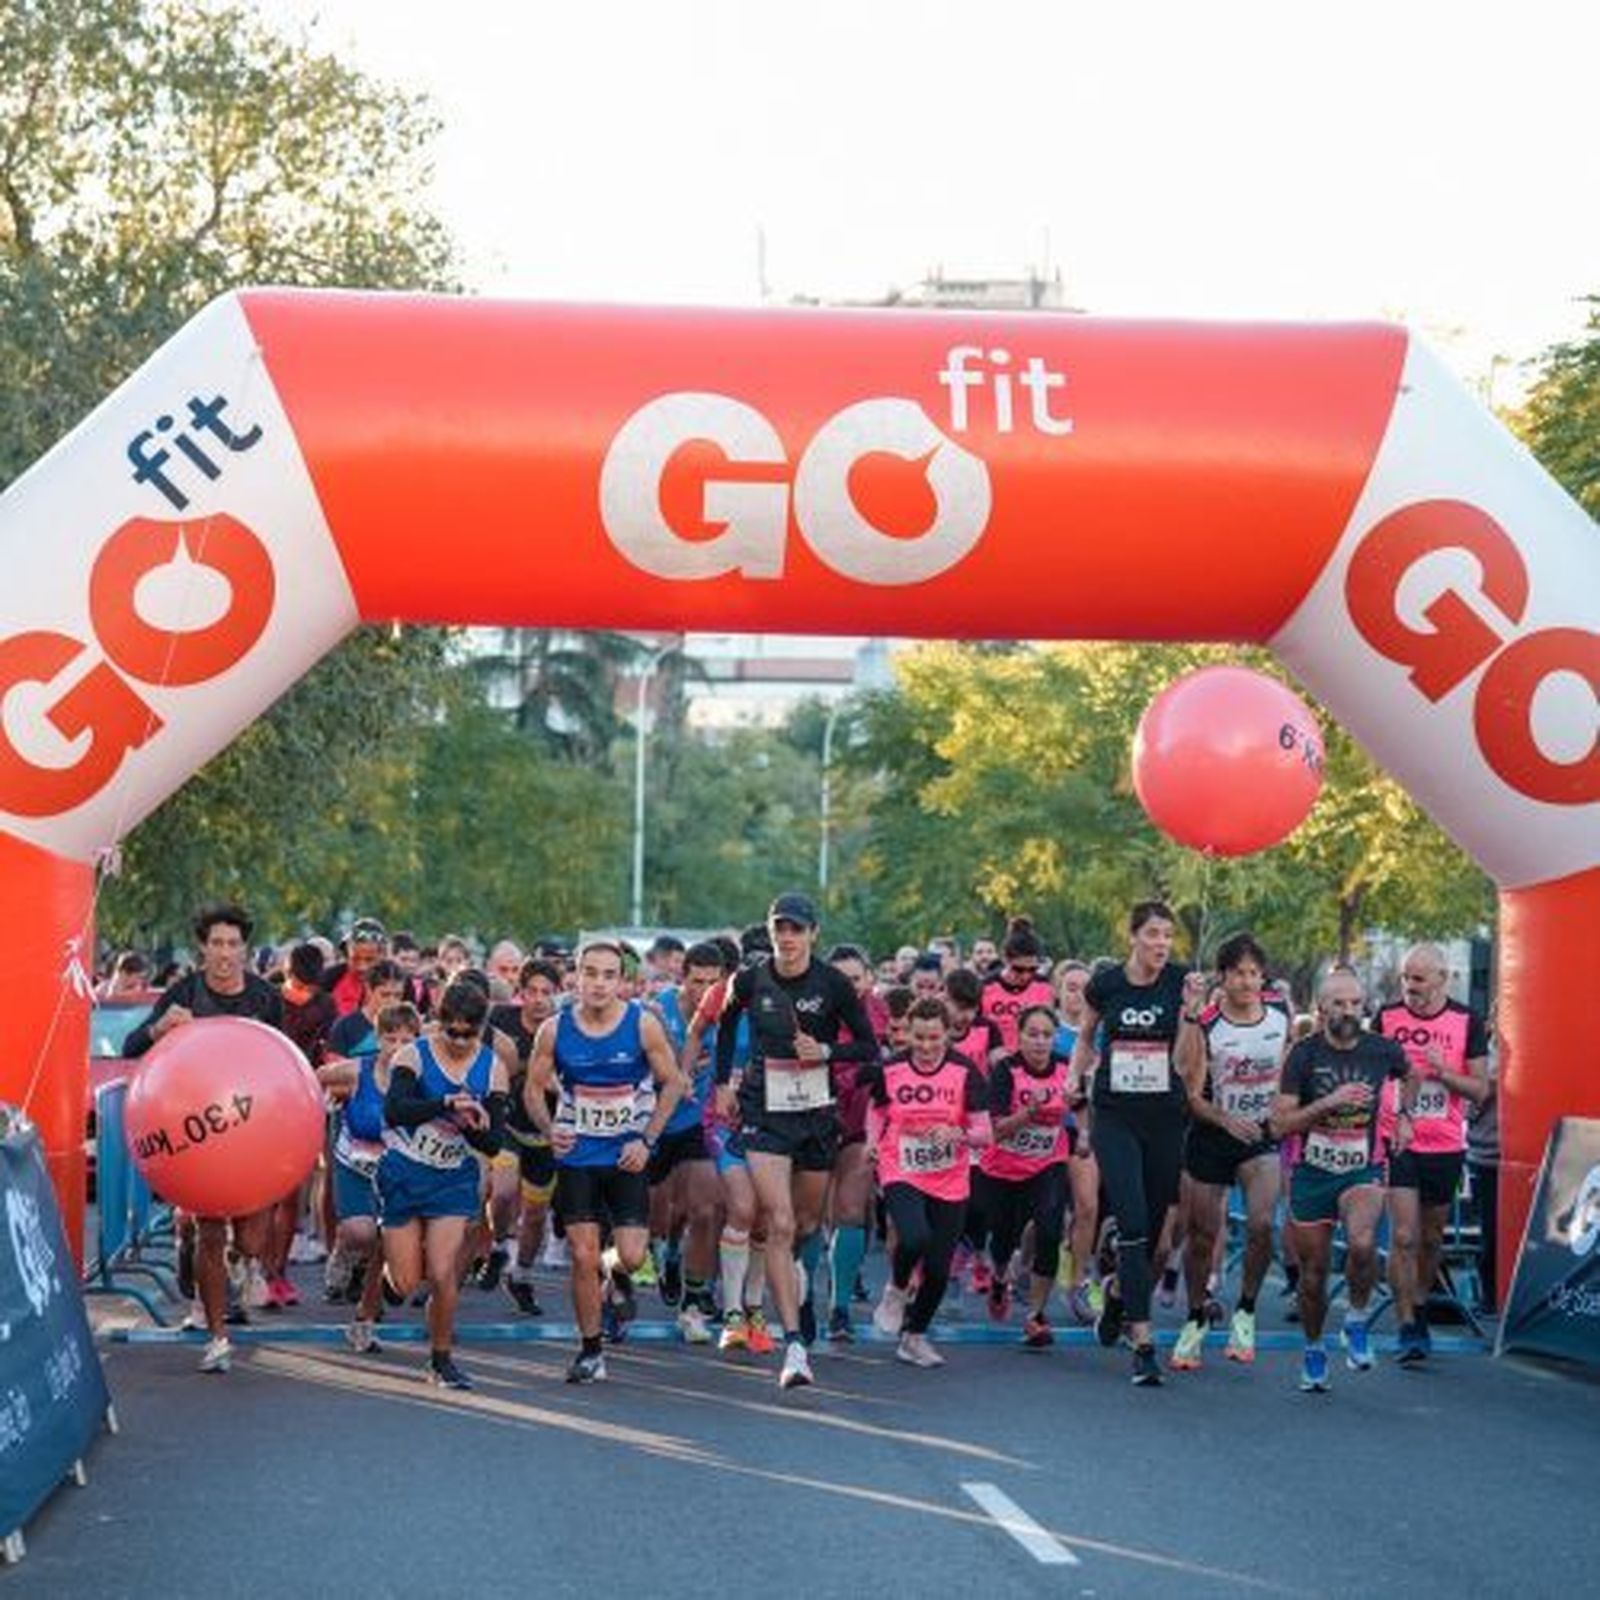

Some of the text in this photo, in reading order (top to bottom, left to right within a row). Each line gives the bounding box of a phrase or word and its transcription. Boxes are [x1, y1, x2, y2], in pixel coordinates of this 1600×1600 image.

[600, 346, 1073, 586] GO fit
[0, 395, 276, 819] GO fit
[1345, 498, 1600, 806] GO
[1121, 1007, 1157, 1026] GO
[1395, 1027, 1431, 1047] GO
[897, 1084, 935, 1104] GO
[580, 1106, 632, 1128] 1752
